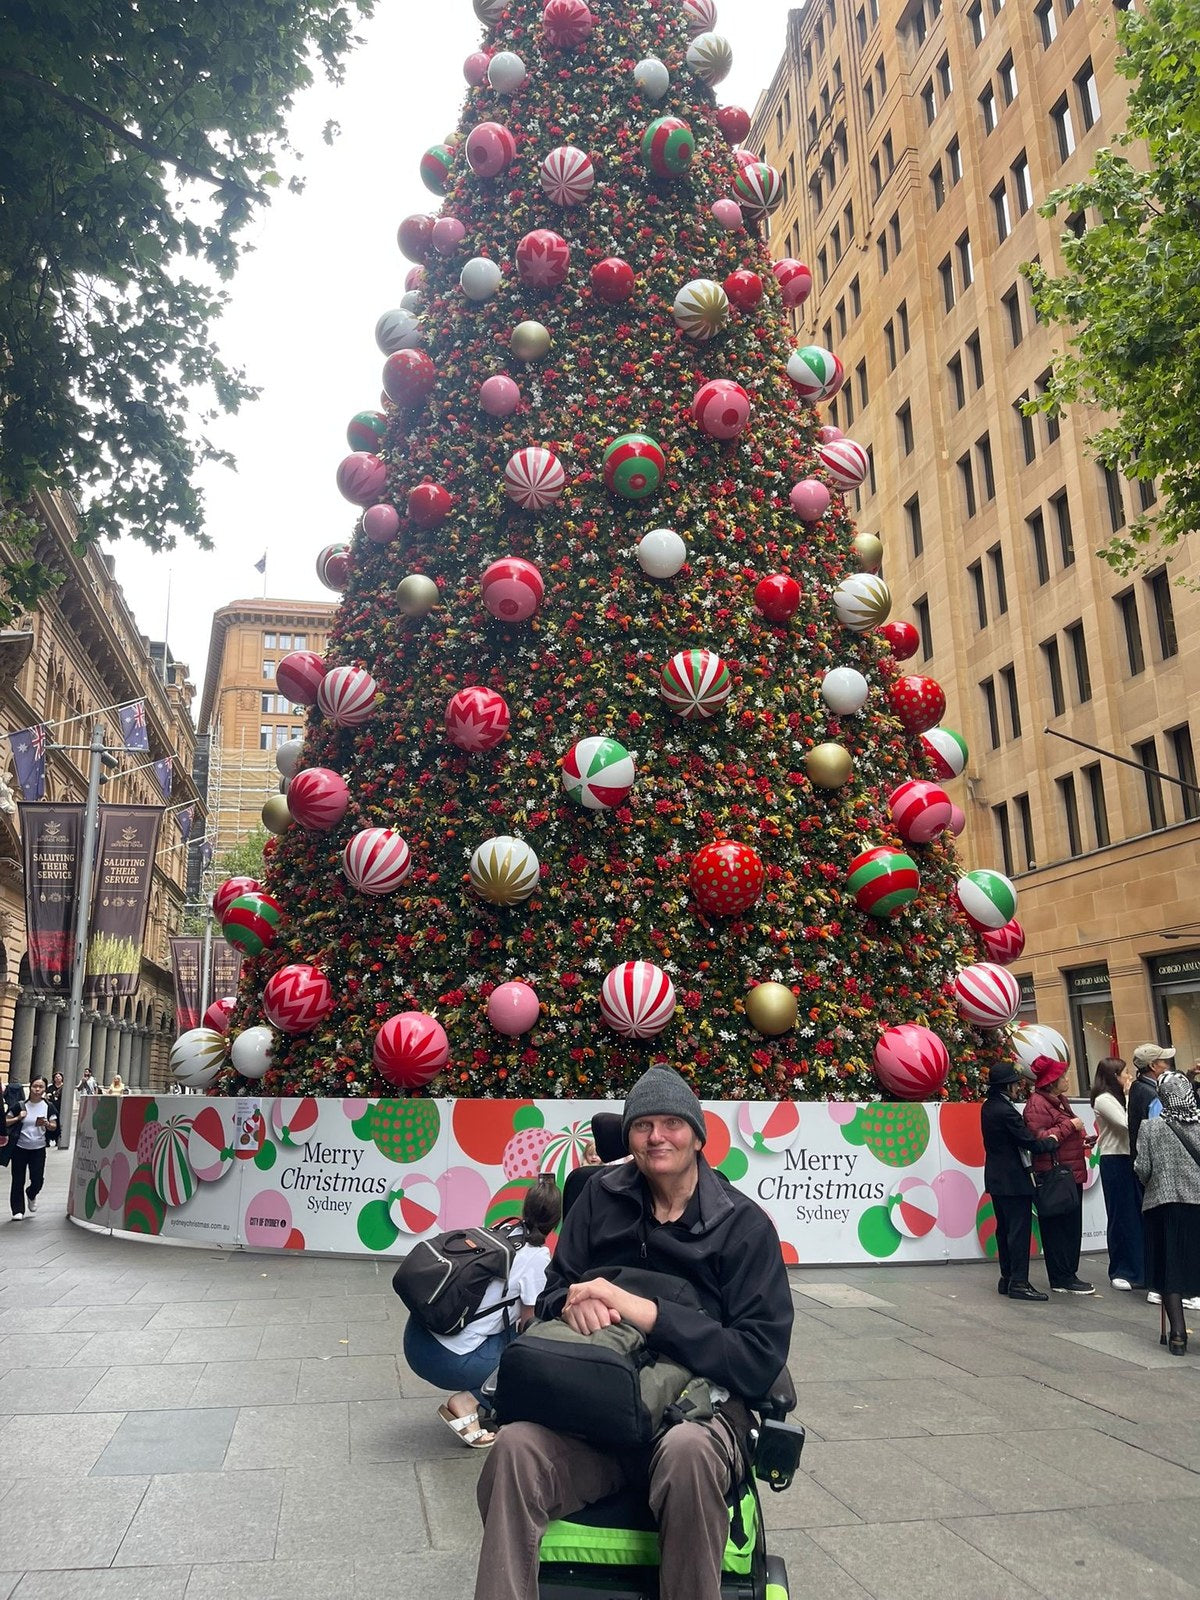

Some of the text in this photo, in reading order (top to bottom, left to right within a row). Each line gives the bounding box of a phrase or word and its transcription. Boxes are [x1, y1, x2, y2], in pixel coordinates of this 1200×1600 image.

[33, 853, 75, 862] SALUTING
[103, 858, 145, 867] SALUTING
[41, 862, 69, 871] THEIR
[110, 867, 137, 875] THEIR
[37, 870, 73, 880] SERVICE
[104, 875, 140, 884] SERVICE
[302, 1142, 365, 1171] Merry
[783, 1148, 858, 1177] Merry
[280, 1166, 387, 1194] Christmas
[757, 1175, 884, 1201] Christmas
[307, 1195, 352, 1215] Sydney
[796, 1204, 850, 1224] Sydney
[170, 1219, 231, 1231] sydneychristmas.com.au
[249, 1217, 259, 1226] CITY
[264, 1218, 279, 1227] SYDNEY
